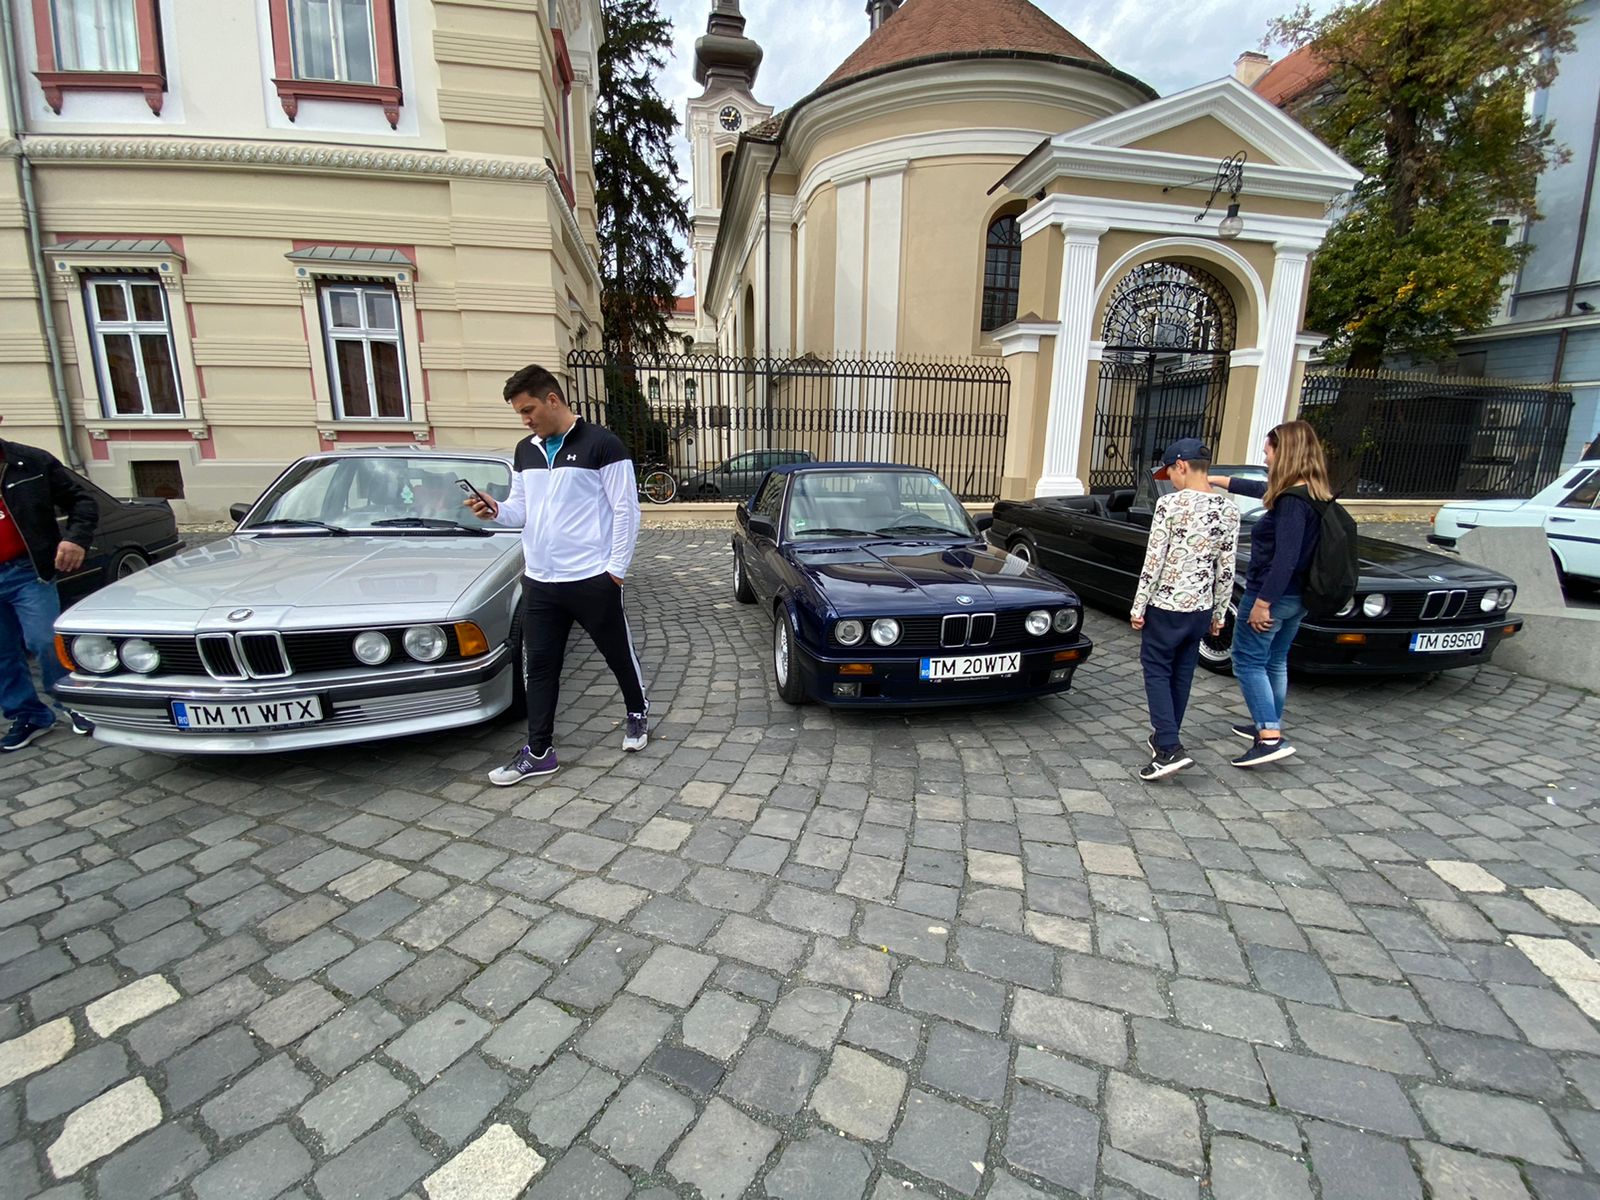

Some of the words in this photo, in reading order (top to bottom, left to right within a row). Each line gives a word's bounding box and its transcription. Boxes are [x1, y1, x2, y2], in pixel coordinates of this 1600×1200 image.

[1419, 635, 1439, 649] TM
[1441, 632, 1482, 649] 69SRO
[931, 659, 956, 676] TM
[177, 716, 188, 725] RO
[189, 706, 225, 725] TM
[231, 706, 251, 725] 11
[257, 700, 316, 723] WTX
